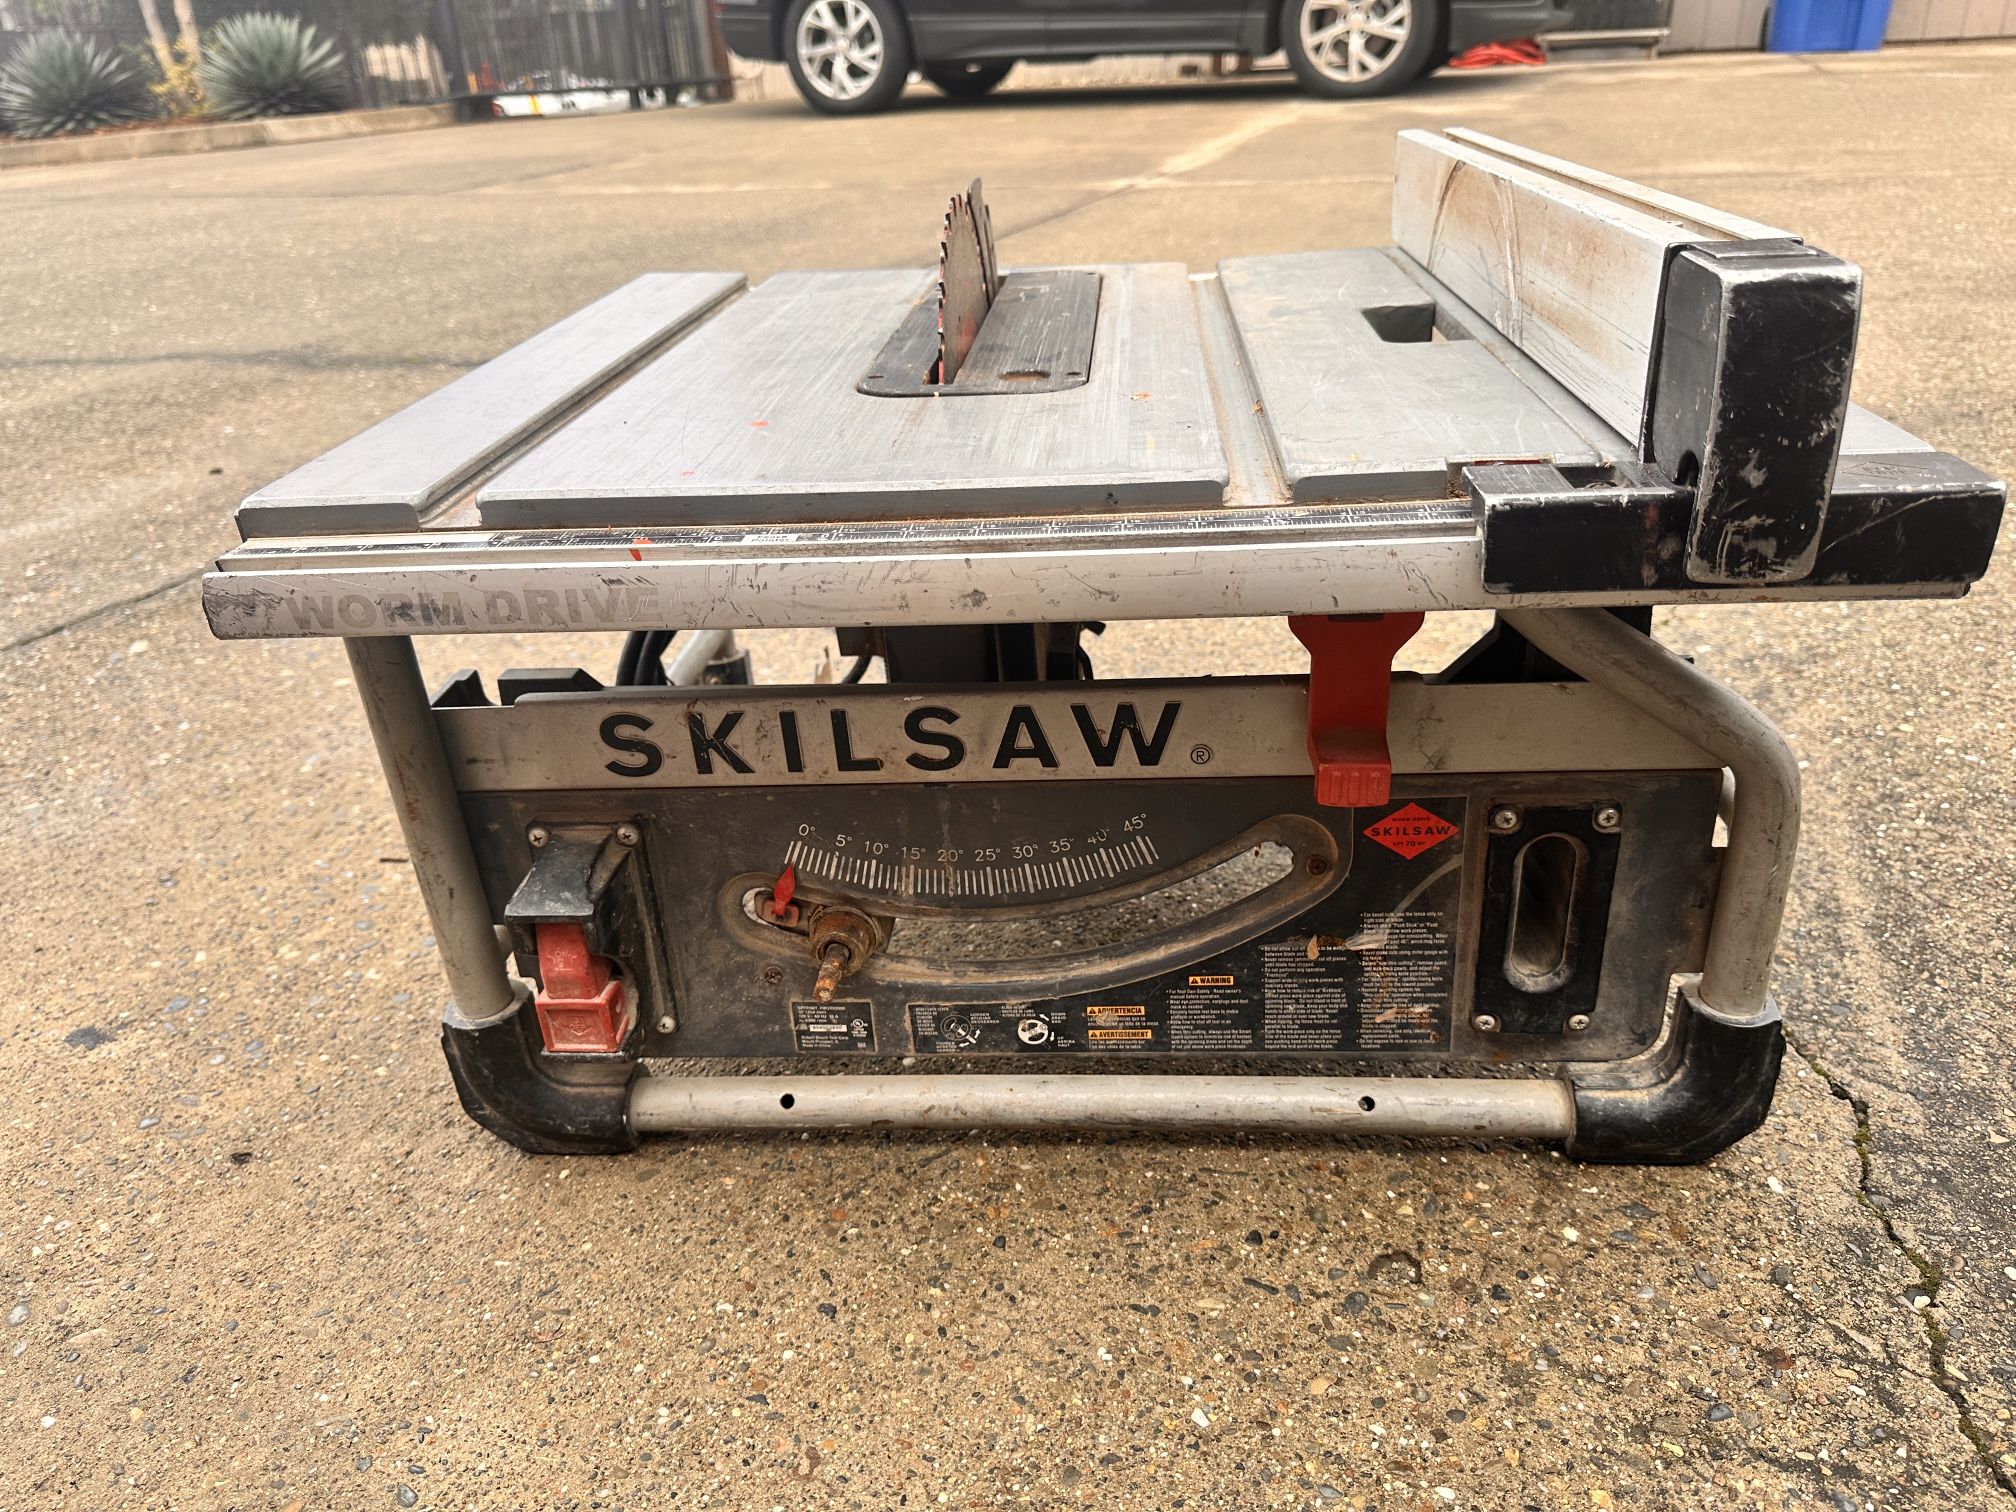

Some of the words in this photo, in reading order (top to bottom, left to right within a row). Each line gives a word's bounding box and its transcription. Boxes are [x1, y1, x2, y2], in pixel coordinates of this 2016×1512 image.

[280, 590, 465, 630] WORM
[482, 586, 664, 627] DRIVE
[599, 702, 1182, 778] SKILSAW
[799, 823, 818, 837] 0°
[836, 834, 853, 848] 5°
[865, 840, 890, 856] 10°
[903, 847, 928, 860] 15°
[937, 849, 965, 862] 20°
[975, 848, 1002, 862] 25°
[1013, 844, 1040, 859] 30°
[1050, 837, 1076, 853] 35°
[1088, 827, 1112, 845] 40°
[1124, 813, 1148, 833] 45°
[1371, 825, 1451, 837] SKILSAW
